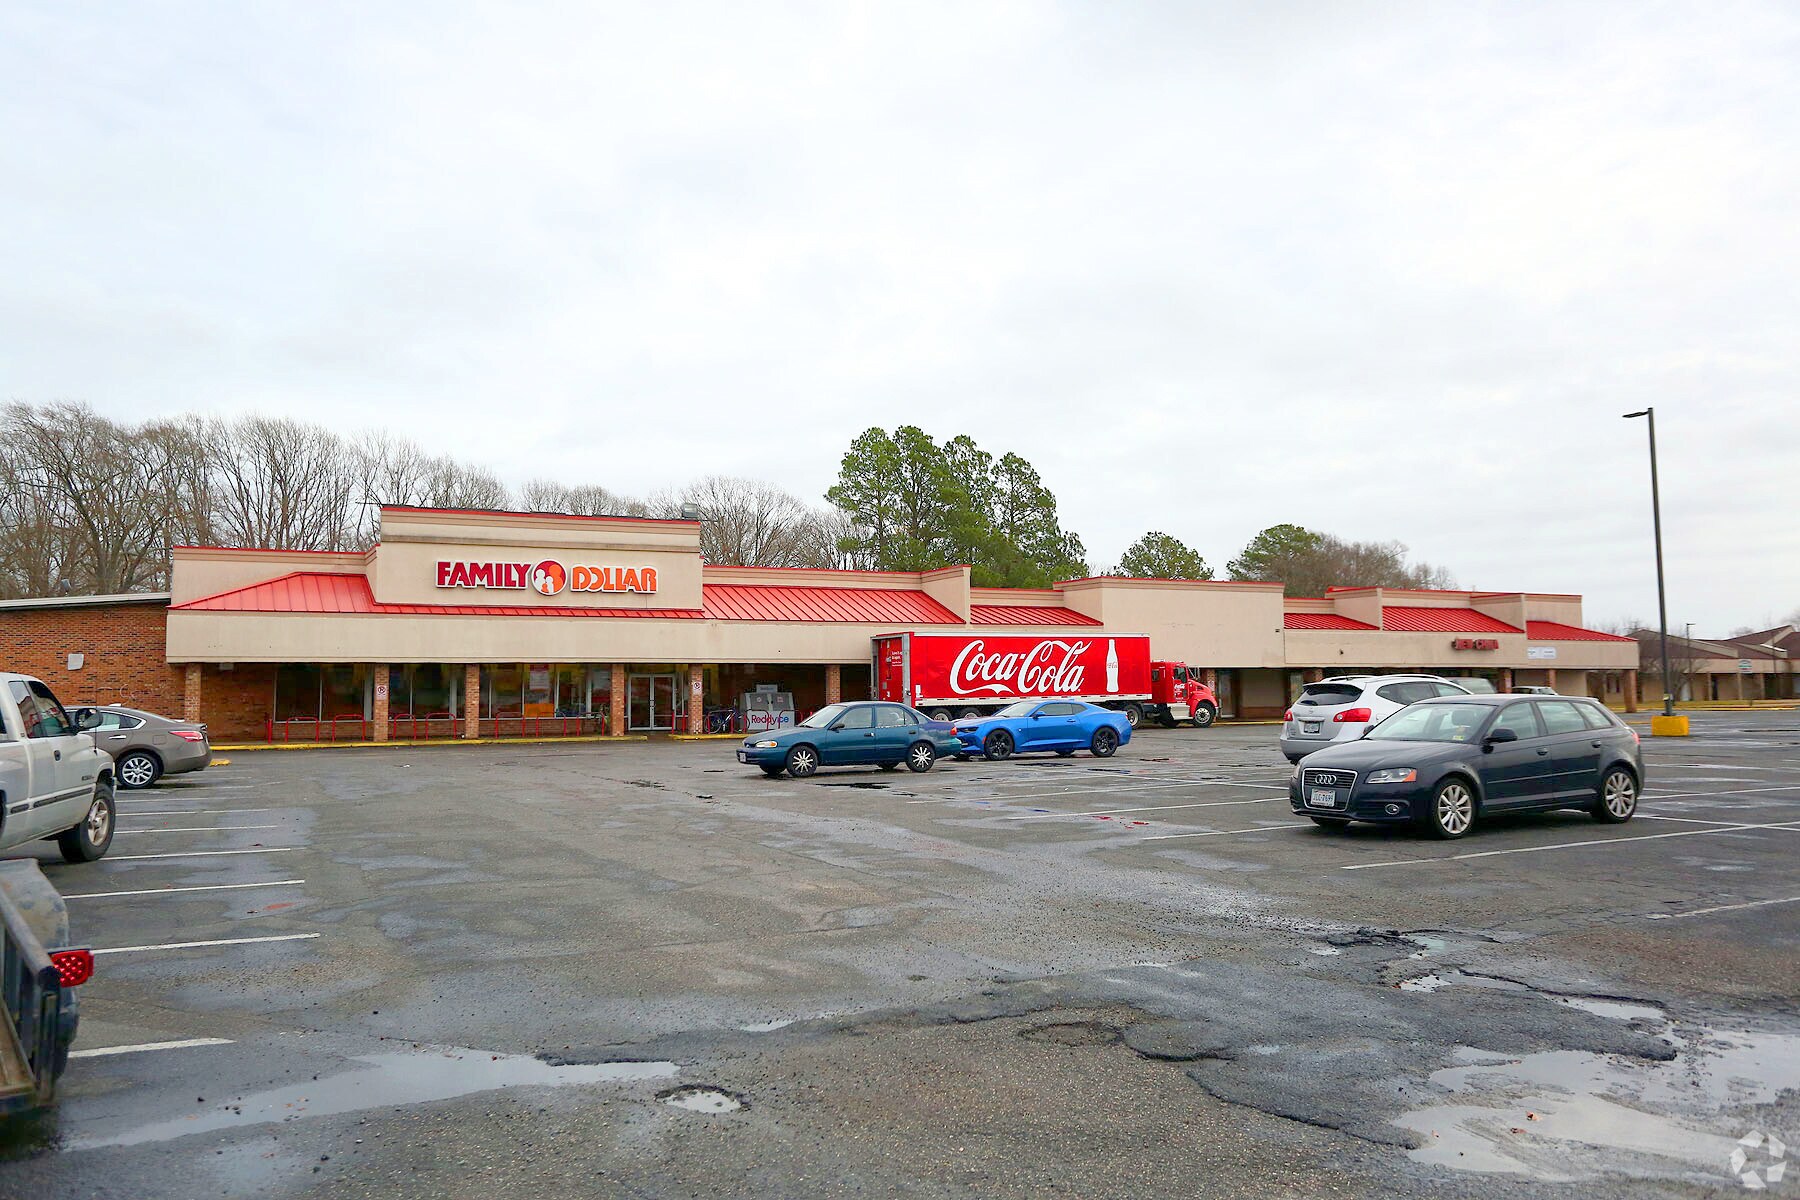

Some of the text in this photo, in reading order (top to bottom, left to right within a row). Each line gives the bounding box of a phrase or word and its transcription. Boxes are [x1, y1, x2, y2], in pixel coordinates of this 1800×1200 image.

[436, 561, 657, 592] FAMILY DOLLAR
[950, 639, 1092, 695] Coca-Cola
[751, 714, 777, 726] Reddy
